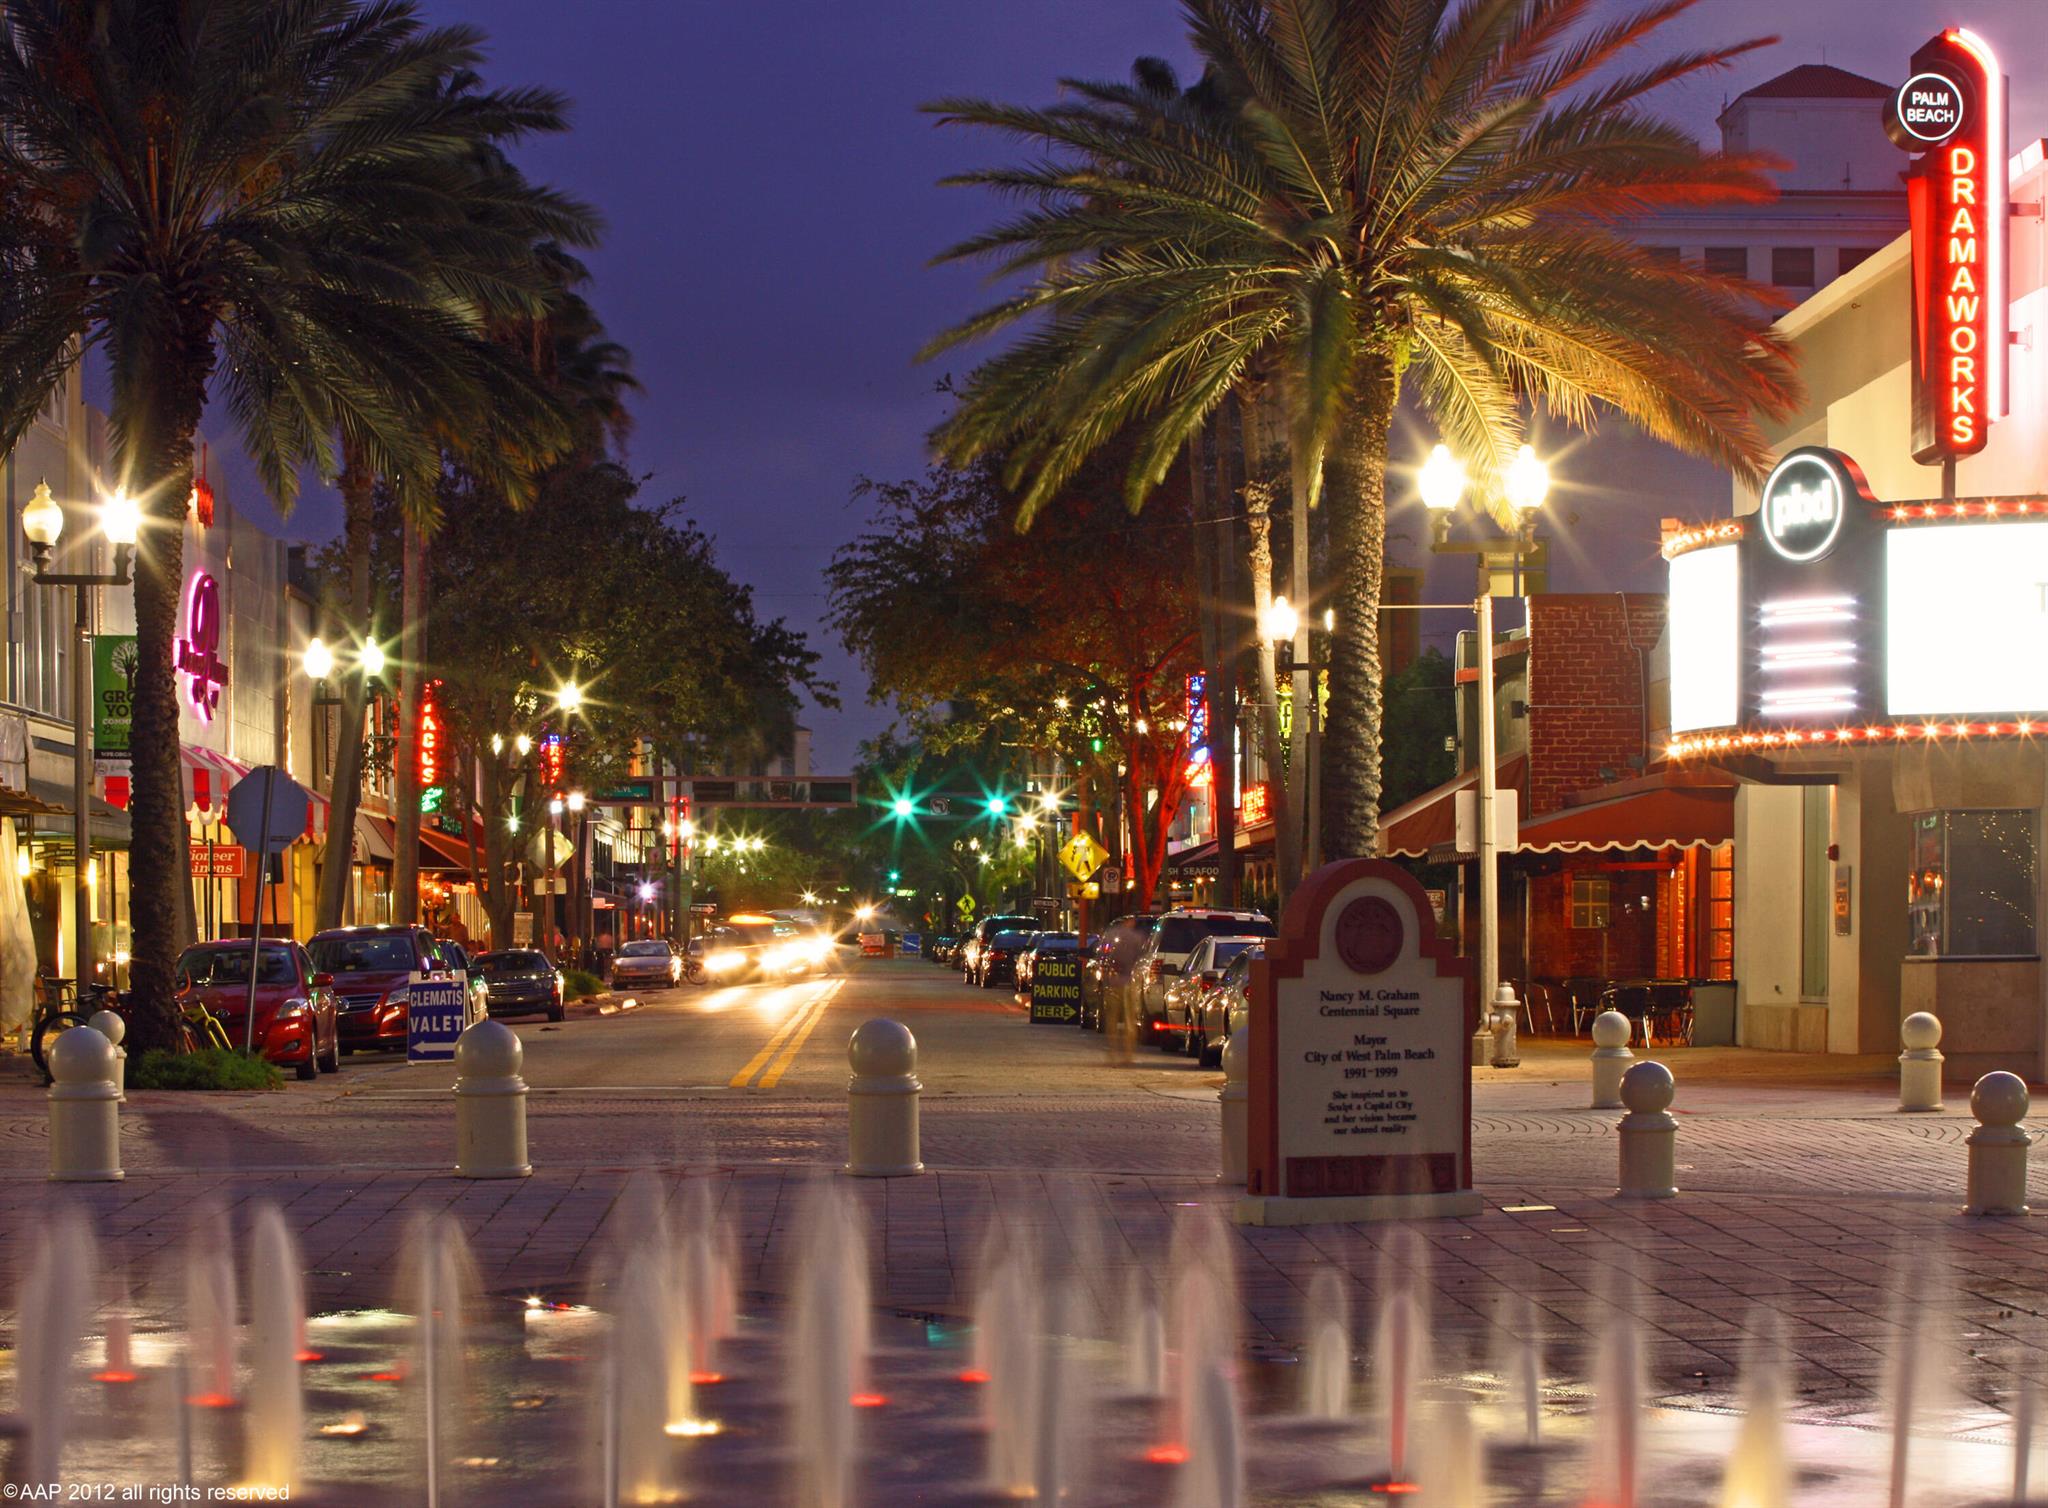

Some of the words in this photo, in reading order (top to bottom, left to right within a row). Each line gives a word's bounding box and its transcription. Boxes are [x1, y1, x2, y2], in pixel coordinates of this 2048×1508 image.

[1912, 92, 1948, 107] PALM
[1907, 107, 1953, 123] BEACH
[1948, 147, 1979, 443] DRAMAWORKS
[1772, 478, 1833, 537] pbd
[102, 690, 135, 703] GRO
[190, 849, 235, 861] ioneer
[1184, 866, 1219, 876] SEAFOO
[1038, 962, 1076, 977] PUBLIC
[410, 989, 463, 1007] CLEMATIS
[1033, 984, 1080, 999] PARKING
[1320, 990, 1354, 1004] Nancy
[1358, 990, 1374, 1001] M.
[1377, 989, 1420, 1001] Graham
[1035, 1005, 1071, 1017] HERE
[1320, 1005, 1379, 1017] Centennial
[1383, 1004, 1420, 1019] Square
[410, 1015, 463, 1032] VALET
[1354, 1034, 1388, 1048] Mayor
[1304, 1051, 1328, 1066] City
[1331, 1050, 1342, 1062] of
[1346, 1050, 1371, 1061] West
[1375, 1049, 1401, 1061] Palm
[1404, 1047, 1435, 1060] Beach
[1333, 1090, 1348, 1099] She
[1351, 1089, 1385, 1101] inspired
[1387, 1090, 1398, 1098] us
[1400, 1089, 1408, 1097] to
[1328, 1102, 1352, 1112] Sculpt
[1364, 1101, 1393, 1112] Capital
[1395, 1100, 1413, 1111] City
[1325, 1115, 1339, 1123] and
[1343, 1114, 1356, 1122] her
[1360, 1113, 1383, 1122] vision
[1387, 1112, 1417, 1121] became
[1351, 1125, 1378, 1134] shared
[1381, 1123, 1407, 1134] reality
